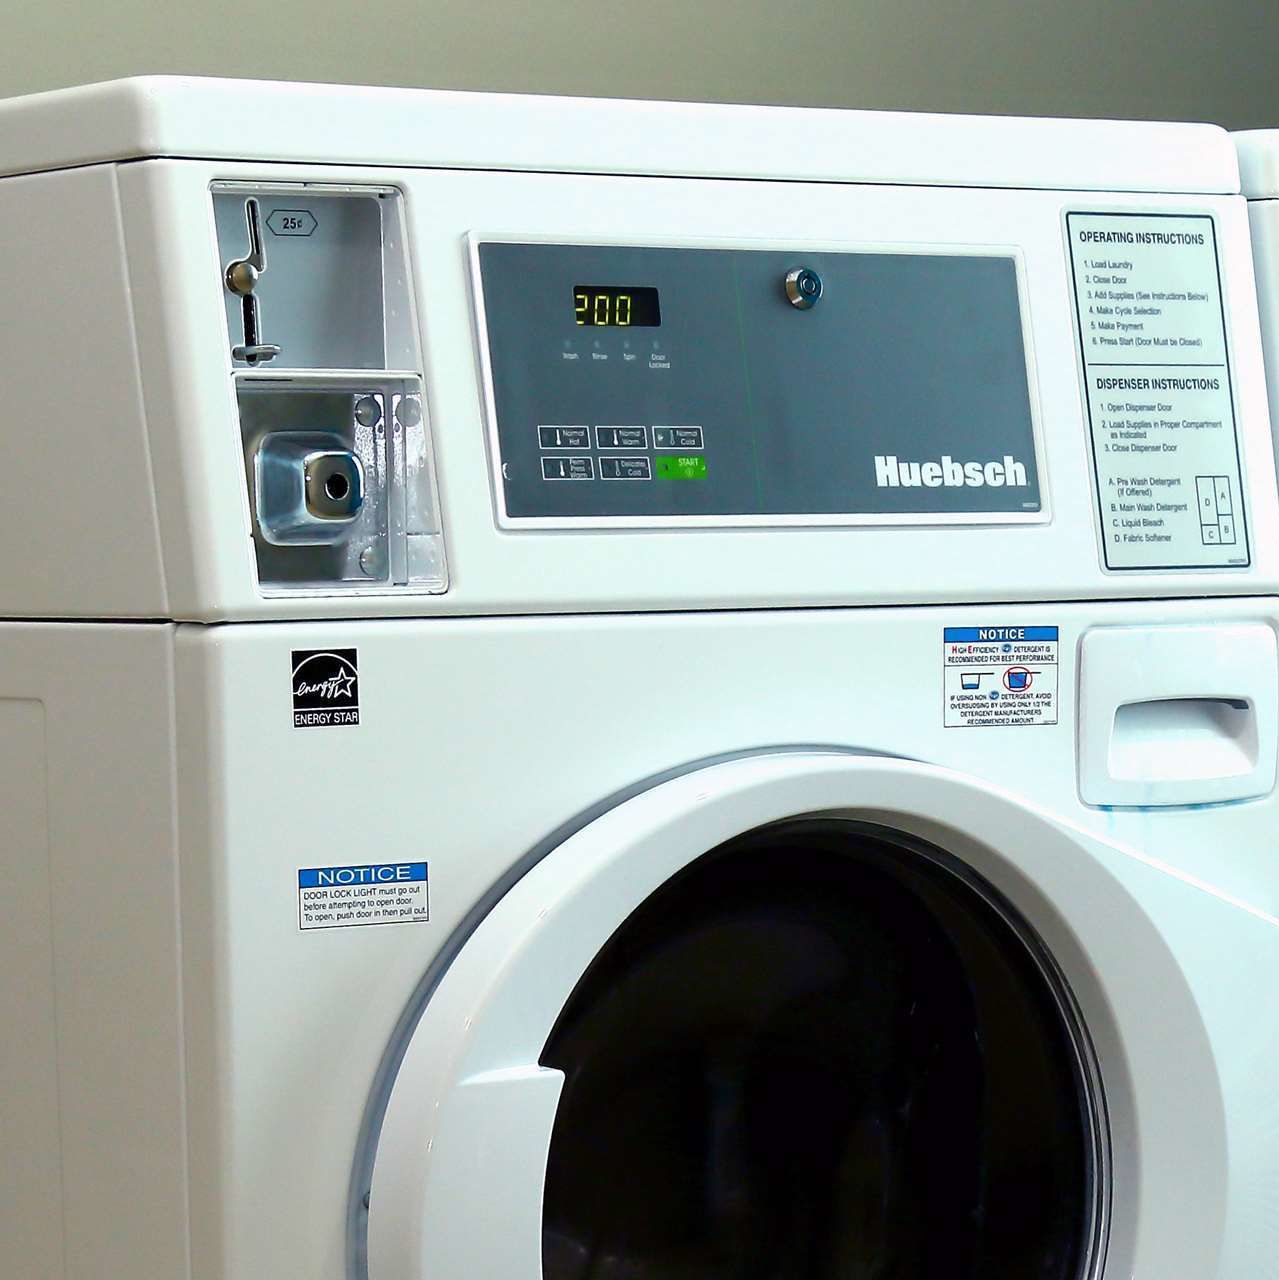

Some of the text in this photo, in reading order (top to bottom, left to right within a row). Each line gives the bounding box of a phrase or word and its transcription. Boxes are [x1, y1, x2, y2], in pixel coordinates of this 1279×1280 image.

[1079, 231, 1205, 245] OPERATING INSTRUCTIONS
[1091, 260, 1106, 269] Load
[1108, 261, 1133, 270] Laundry
[1093, 276, 1110, 284] Close
[1112, 276, 1127, 284] Door
[1094, 291, 1108, 300] Add
[576, 295, 630, 325] 200
[1097, 307, 1113, 315] Make
[1115, 307, 1132, 317] Cycle
[1098, 322, 1115, 330] Make
[1116, 322, 1143, 332] Payment
[1154, 338, 1168, 346] Must
[1170, 338, 1178, 346] be
[1097, 378, 1219, 390] DISPENSER INSTRUCTIONS
[1108, 404, 1124, 412] Open
[1125, 404, 1156, 412] Dispenser
[1157, 404, 1172, 412] Door
[1160, 421, 1181, 429] Proper
[1182, 421, 1222, 430] Compartment
[1112, 444, 1129, 452] Close
[1131, 444, 1161, 453] Dispenser
[678, 458, 699, 466] START
[874, 455, 1027, 487] Huebsch
[1130, 478, 1148, 486] Wash
[1150, 478, 1180, 487] Detergent
[1205, 498, 1210, 506] D
[1112, 504, 1117, 512] B.
[1156, 504, 1187, 512] Detergent
[1113, 519, 1164, 528] C. Liquid Bleach
[979, 629, 1025, 639] NOTICE
[295, 712, 358, 725] ENERGY STAR
[318, 866, 411, 884] NOTICE
[304, 891, 328, 900] DOOR
[330, 890, 351, 898] LOCK
[354, 888, 377, 897] LIGHT
[304, 902, 326, 910] before
[328, 900, 366, 909] attempting
[376, 898, 394, 906] open
[304, 913, 313, 921] To
[336, 911, 354, 920] push
[356, 910, 372, 918] door
[382, 908, 398, 916] then
[400, 907, 412, 916] pull
